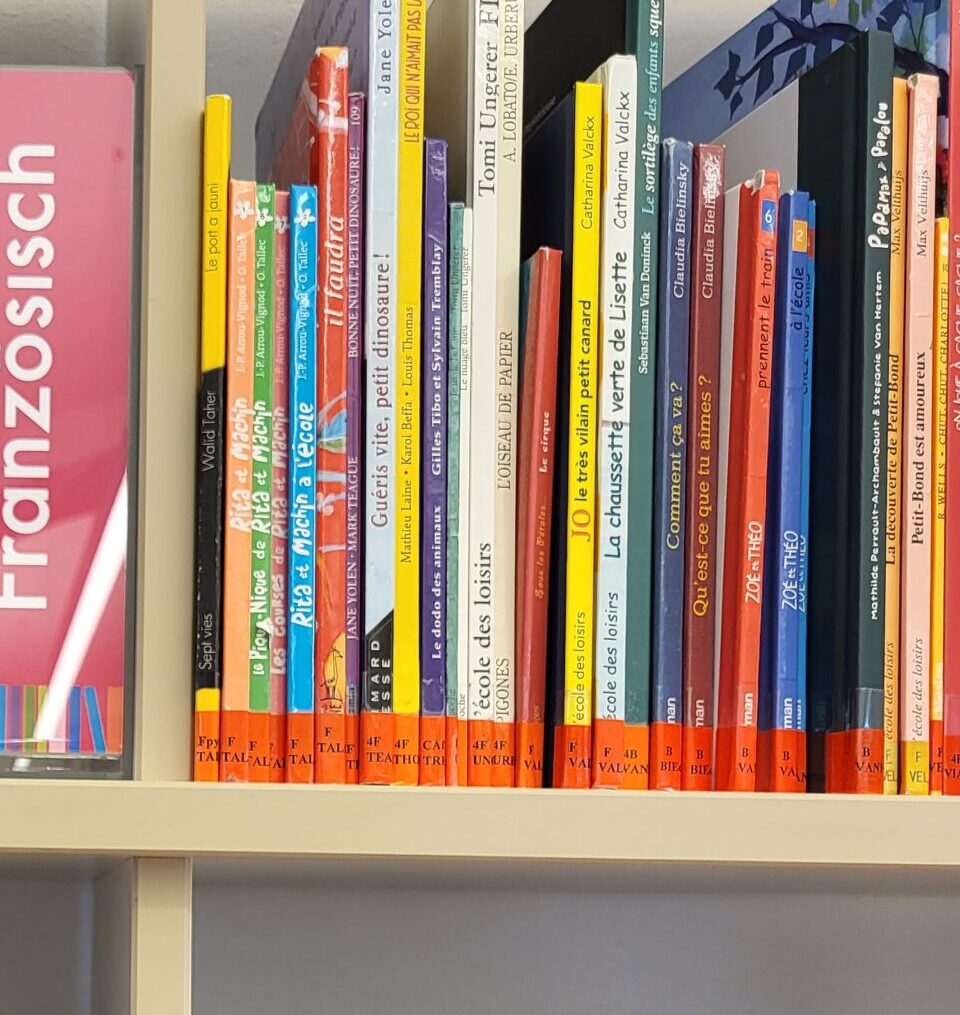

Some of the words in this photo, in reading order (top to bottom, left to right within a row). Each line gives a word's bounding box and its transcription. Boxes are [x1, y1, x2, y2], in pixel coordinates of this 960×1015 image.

[479, 41, 499, 130] Ungerer
[645, 41, 660, 94] enfants
[644, 98, 658, 121] des
[477, 139, 497, 197] Tomi
[643, 124, 659, 193] sortilège
[642, 194, 655, 214] Le
[675, 161, 689, 234] Bielinsky
[608, 251, 628, 321] Lisette
[673, 237, 686, 299] Claudia
[759, 248, 774, 288] train
[756, 293, 772, 309] le
[578, 299, 592, 355] canard
[608, 328, 627, 352] de
[499, 331, 513, 386] PAPIER
[757, 314, 773, 389] prennent
[578, 359, 593, 399] petit
[611, 360, 626, 413] verte
[913, 352, 928, 433] amoureux
[203, 390, 218, 425] Taher
[498, 392, 513, 414] DE
[575, 404, 591, 447] vilain
[201, 429, 217, 472] Walid
[498, 420, 512, 491] L'OISEAU
[575, 449, 589, 483] très
[912, 437, 925, 457] est
[575, 488, 589, 502] le
[603, 420, 625, 529] chaussette
[911, 460, 925, 545] Petit-Bond
[431, 505, 442, 568] animaux
[570, 509, 592, 543] JO
[603, 535, 622, 559] La
[431, 572, 442, 597] des
[200, 613, 213, 638] vies
[431, 600, 442, 637] dodo
[199, 641, 215, 670] Sept
[431, 641, 442, 659] Le
